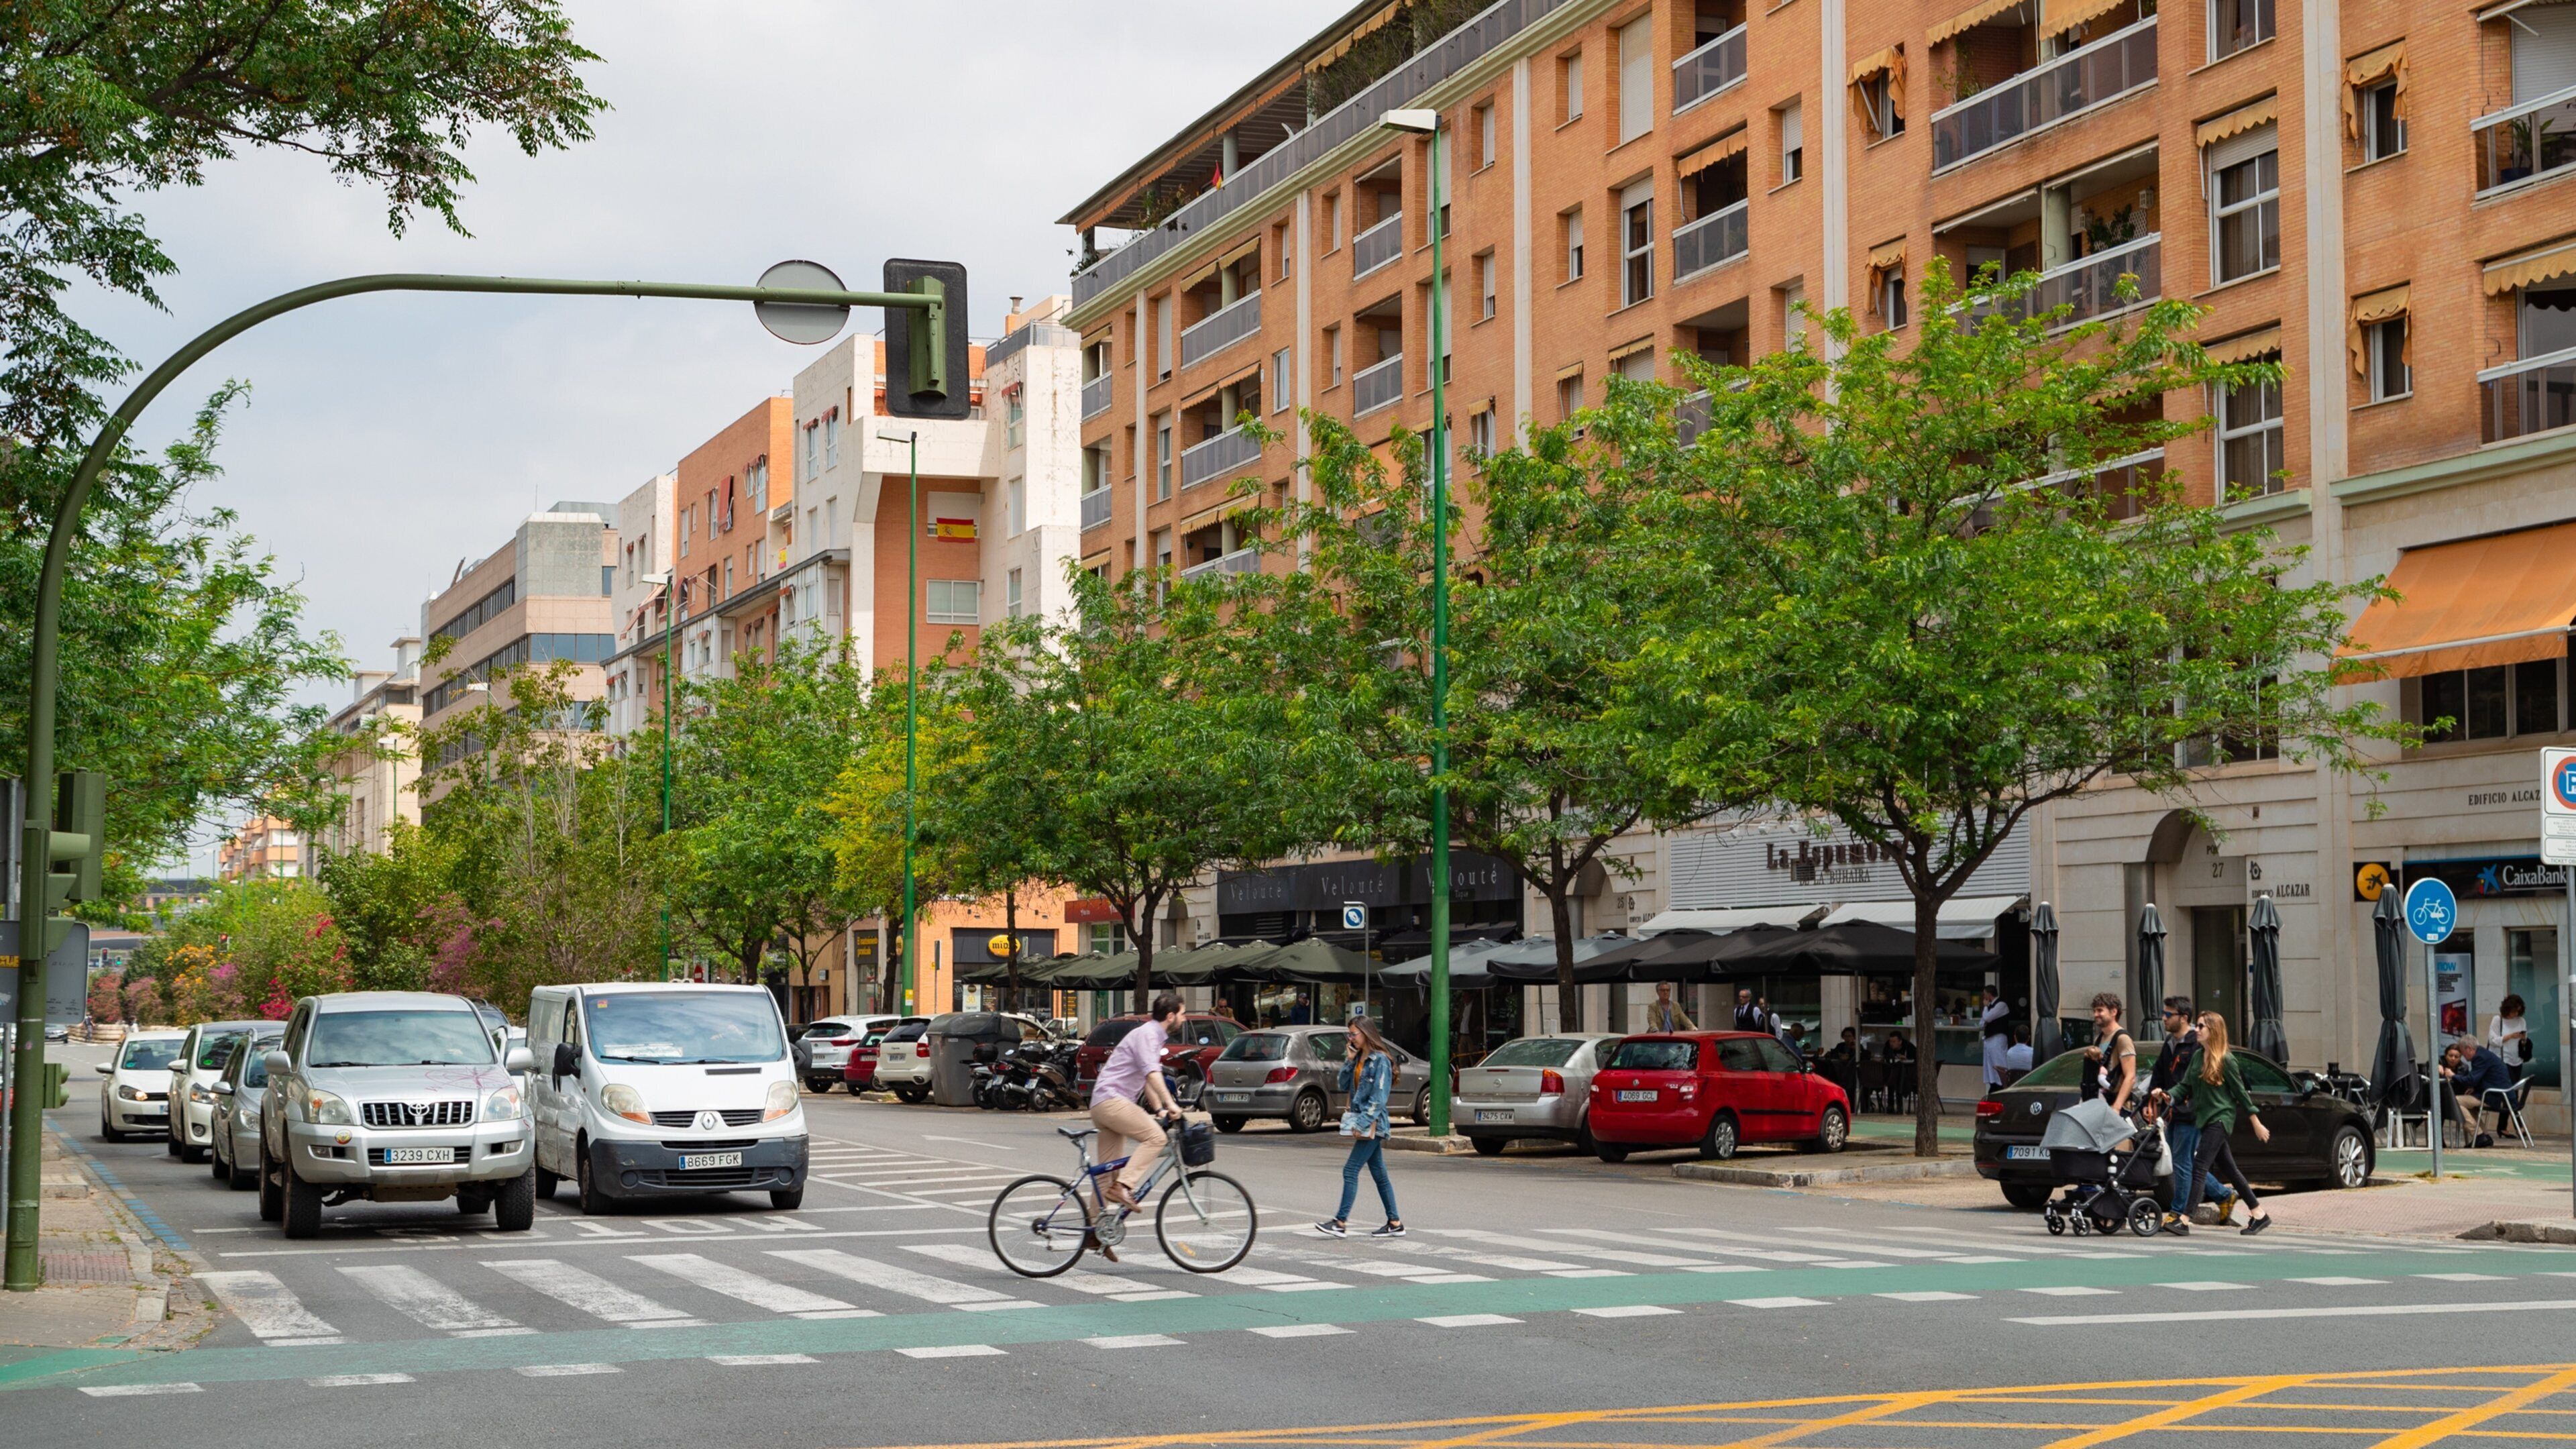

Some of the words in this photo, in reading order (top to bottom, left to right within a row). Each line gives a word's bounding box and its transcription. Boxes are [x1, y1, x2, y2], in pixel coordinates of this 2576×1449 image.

[2469, 792, 2507, 805] EDIFICIO
[2512, 790, 2540, 802] ALCAZ
[1766, 843, 1789, 869] La
[1799, 840, 1902, 872] Espumos
[1426, 863, 1497, 888] Vlouté
[1830, 868, 1870, 884] BUHAIRA
[2212, 863, 2224, 878] 27
[2503, 865, 2567, 886] CaixaBank
[1230, 881, 1282, 901] Velouté
[1322, 873, 1383, 896] Velouté
[2276, 883, 2310, 898] ALCAZAR
[392, 1150, 423, 1161] 3239
[427, 1150, 449, 1161] CXH
[2014, 1148, 2036, 1157] 7091
[688, 1156, 715, 1167] 8669
[718, 1154, 739, 1165] FGK
